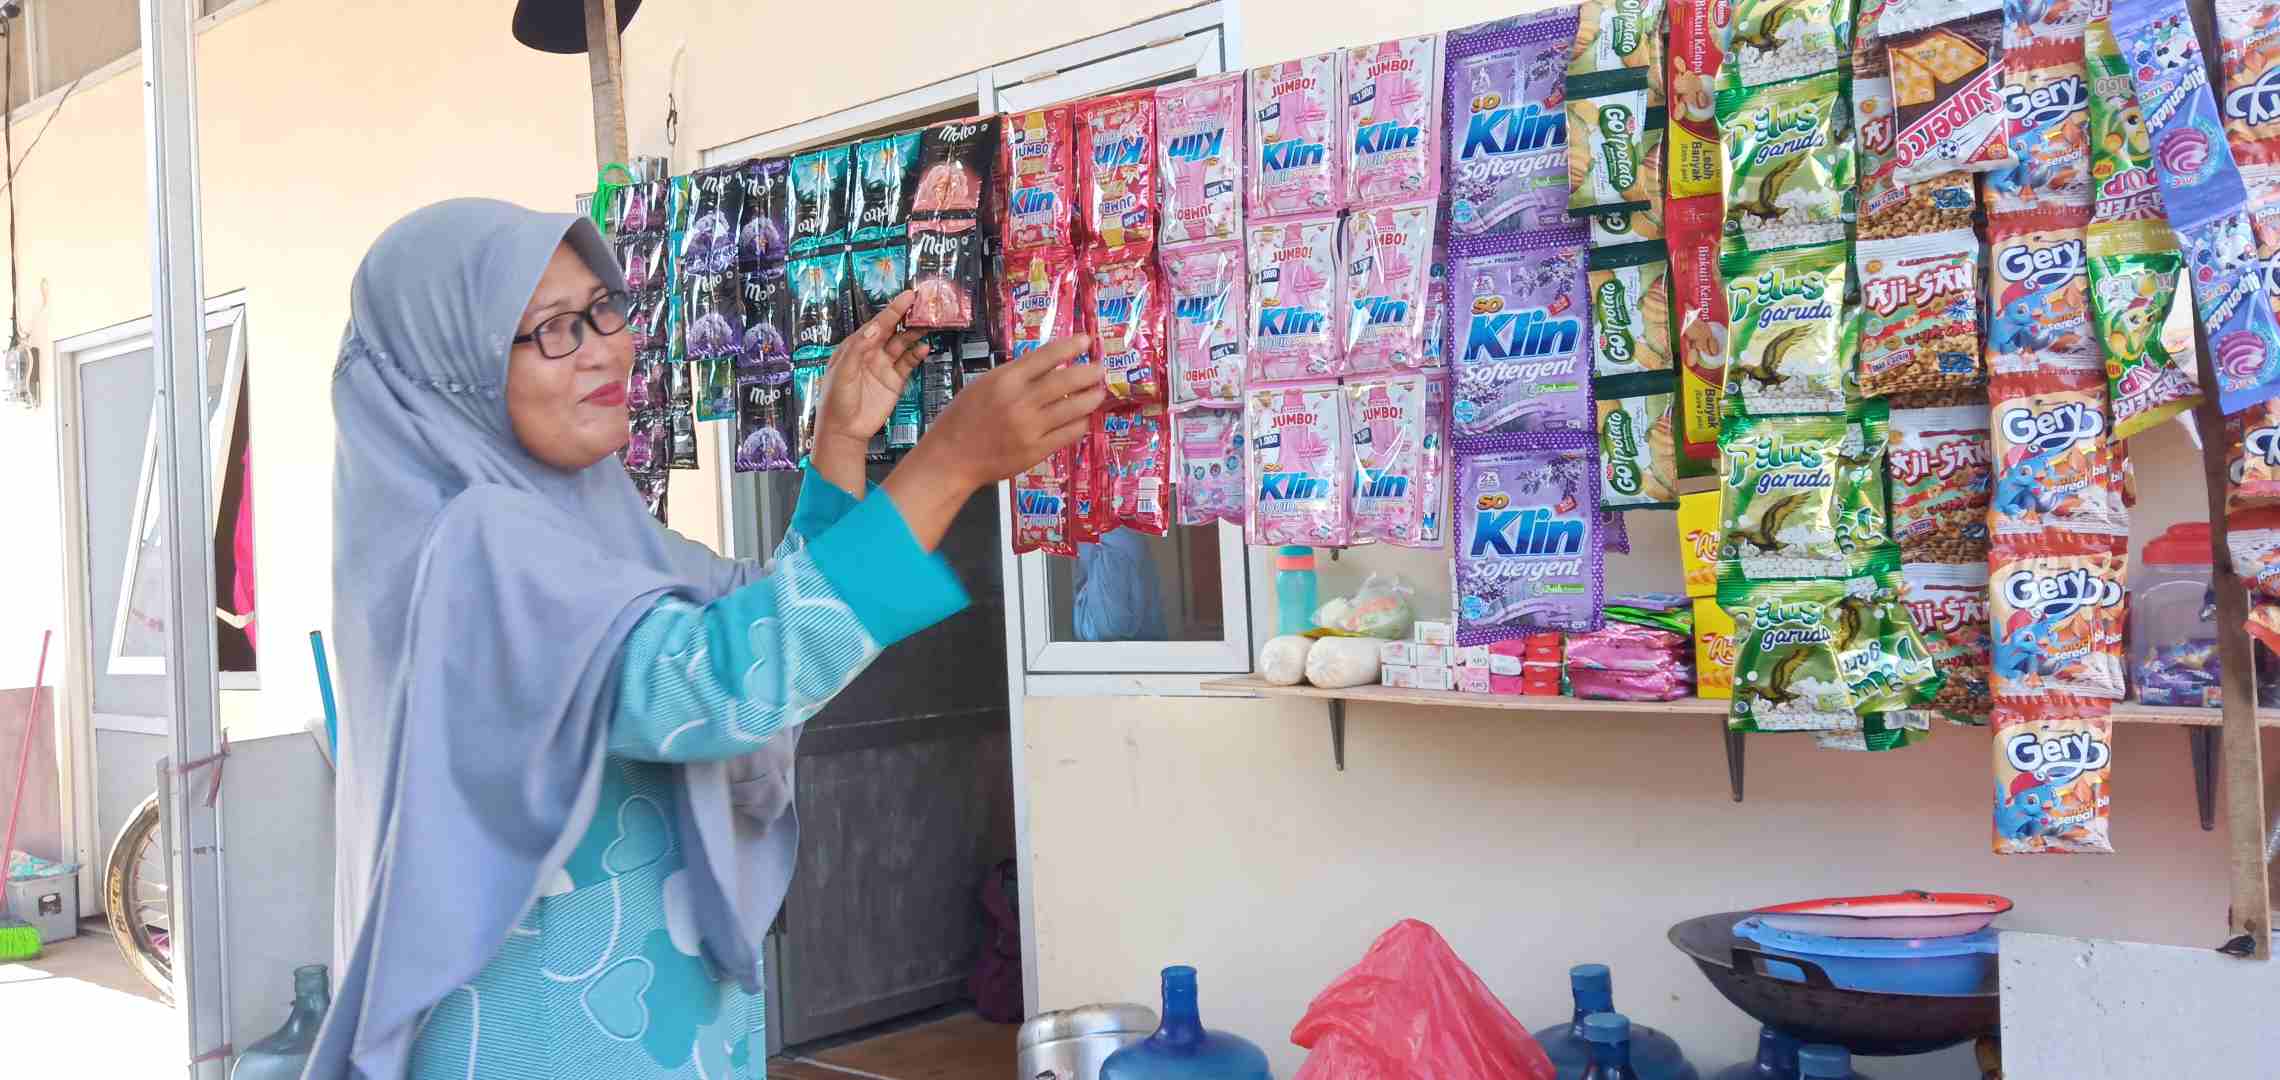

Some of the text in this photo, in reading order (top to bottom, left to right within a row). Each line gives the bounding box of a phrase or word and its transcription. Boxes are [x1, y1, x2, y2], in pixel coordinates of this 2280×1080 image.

[1367, 59, 1414, 80] JUMBO!
[1271, 78, 1316, 99] JUMBO!
[2000, 76, 2086, 125] Gery
[938, 125, 977, 144] Molto
[1168, 128, 1225, 164] Klin
[1355, 121, 1420, 155] Klin
[1461, 104, 1568, 161] Klin
[1724, 101, 1819, 161] Pilus
[1263, 139, 1325, 172] Klin
[1690, 142, 1703, 182] Banyak
[1755, 129, 1825, 166] garuda
[1011, 187, 1056, 218] Klin
[1100, 196, 1132, 214] JUMB
[1271, 246, 1313, 264] JUMBO!
[1999, 240, 2087, 290] Gery
[1728, 267, 1825, 323] Pilus
[1258, 306, 1326, 338] Klin
[1758, 301, 1833, 329] garuda
[1464, 309, 1581, 361] Klin
[1463, 357, 1578, 386] Softergent
[1271, 413, 1319, 429] JUMBO!
[1362, 407, 1404, 423] JUMBO!
[2002, 402, 2104, 453] Gery
[1726, 433, 1824, 487] Pilus
[1260, 472, 1330, 501] Klin
[1757, 470, 1832, 494] garuda
[1016, 489, 1062, 516] Klin
[1471, 508, 1585, 557] Klin
[1471, 557, 1584, 584] Softergent
[2004, 568, 2105, 618] Gery
[1761, 626, 1832, 653] garuda
[2007, 731, 2110, 783] Gery
